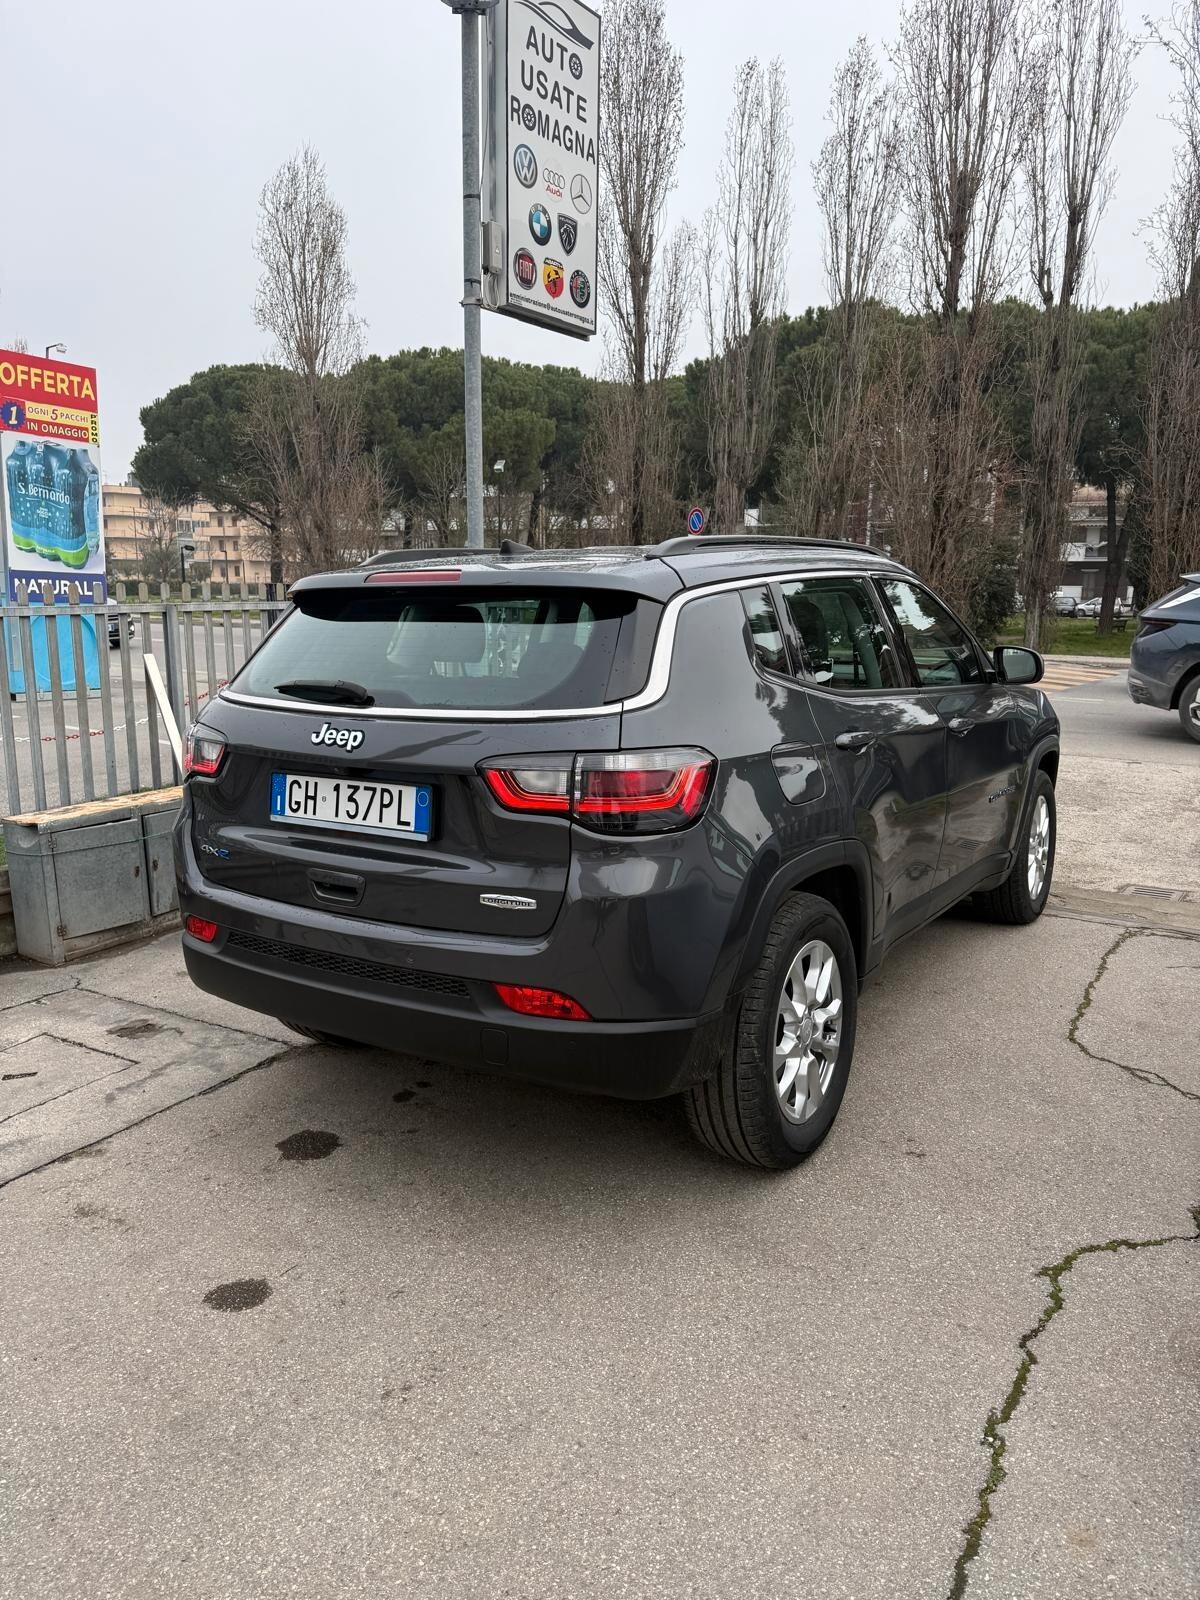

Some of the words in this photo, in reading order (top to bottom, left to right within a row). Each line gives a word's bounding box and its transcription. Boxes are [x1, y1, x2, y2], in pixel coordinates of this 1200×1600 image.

[526, 26, 583, 80] AUTO
[521, 59, 587, 123] USATE
[511, 95, 596, 165] ROMAGNA
[546, 184, 563, 198] Audi
[520, 260, 533, 281] FIAT
[0, 361, 96, 401] OFFERTA
[9, 406, 18, 425] 1
[27, 406, 49, 416] OGNI
[50, 408, 59, 421] 5
[60, 412, 89, 423] PACCHI
[90, 414, 98, 443] PROMO
[27, 421, 38, 431] IN
[41, 423, 89, 439] OMAGGIO
[14, 578, 102, 596] NATURAL
[311, 723, 365, 752] Jeep
[288, 779, 319, 816] GH
[333, 783, 412, 827] 137PL
